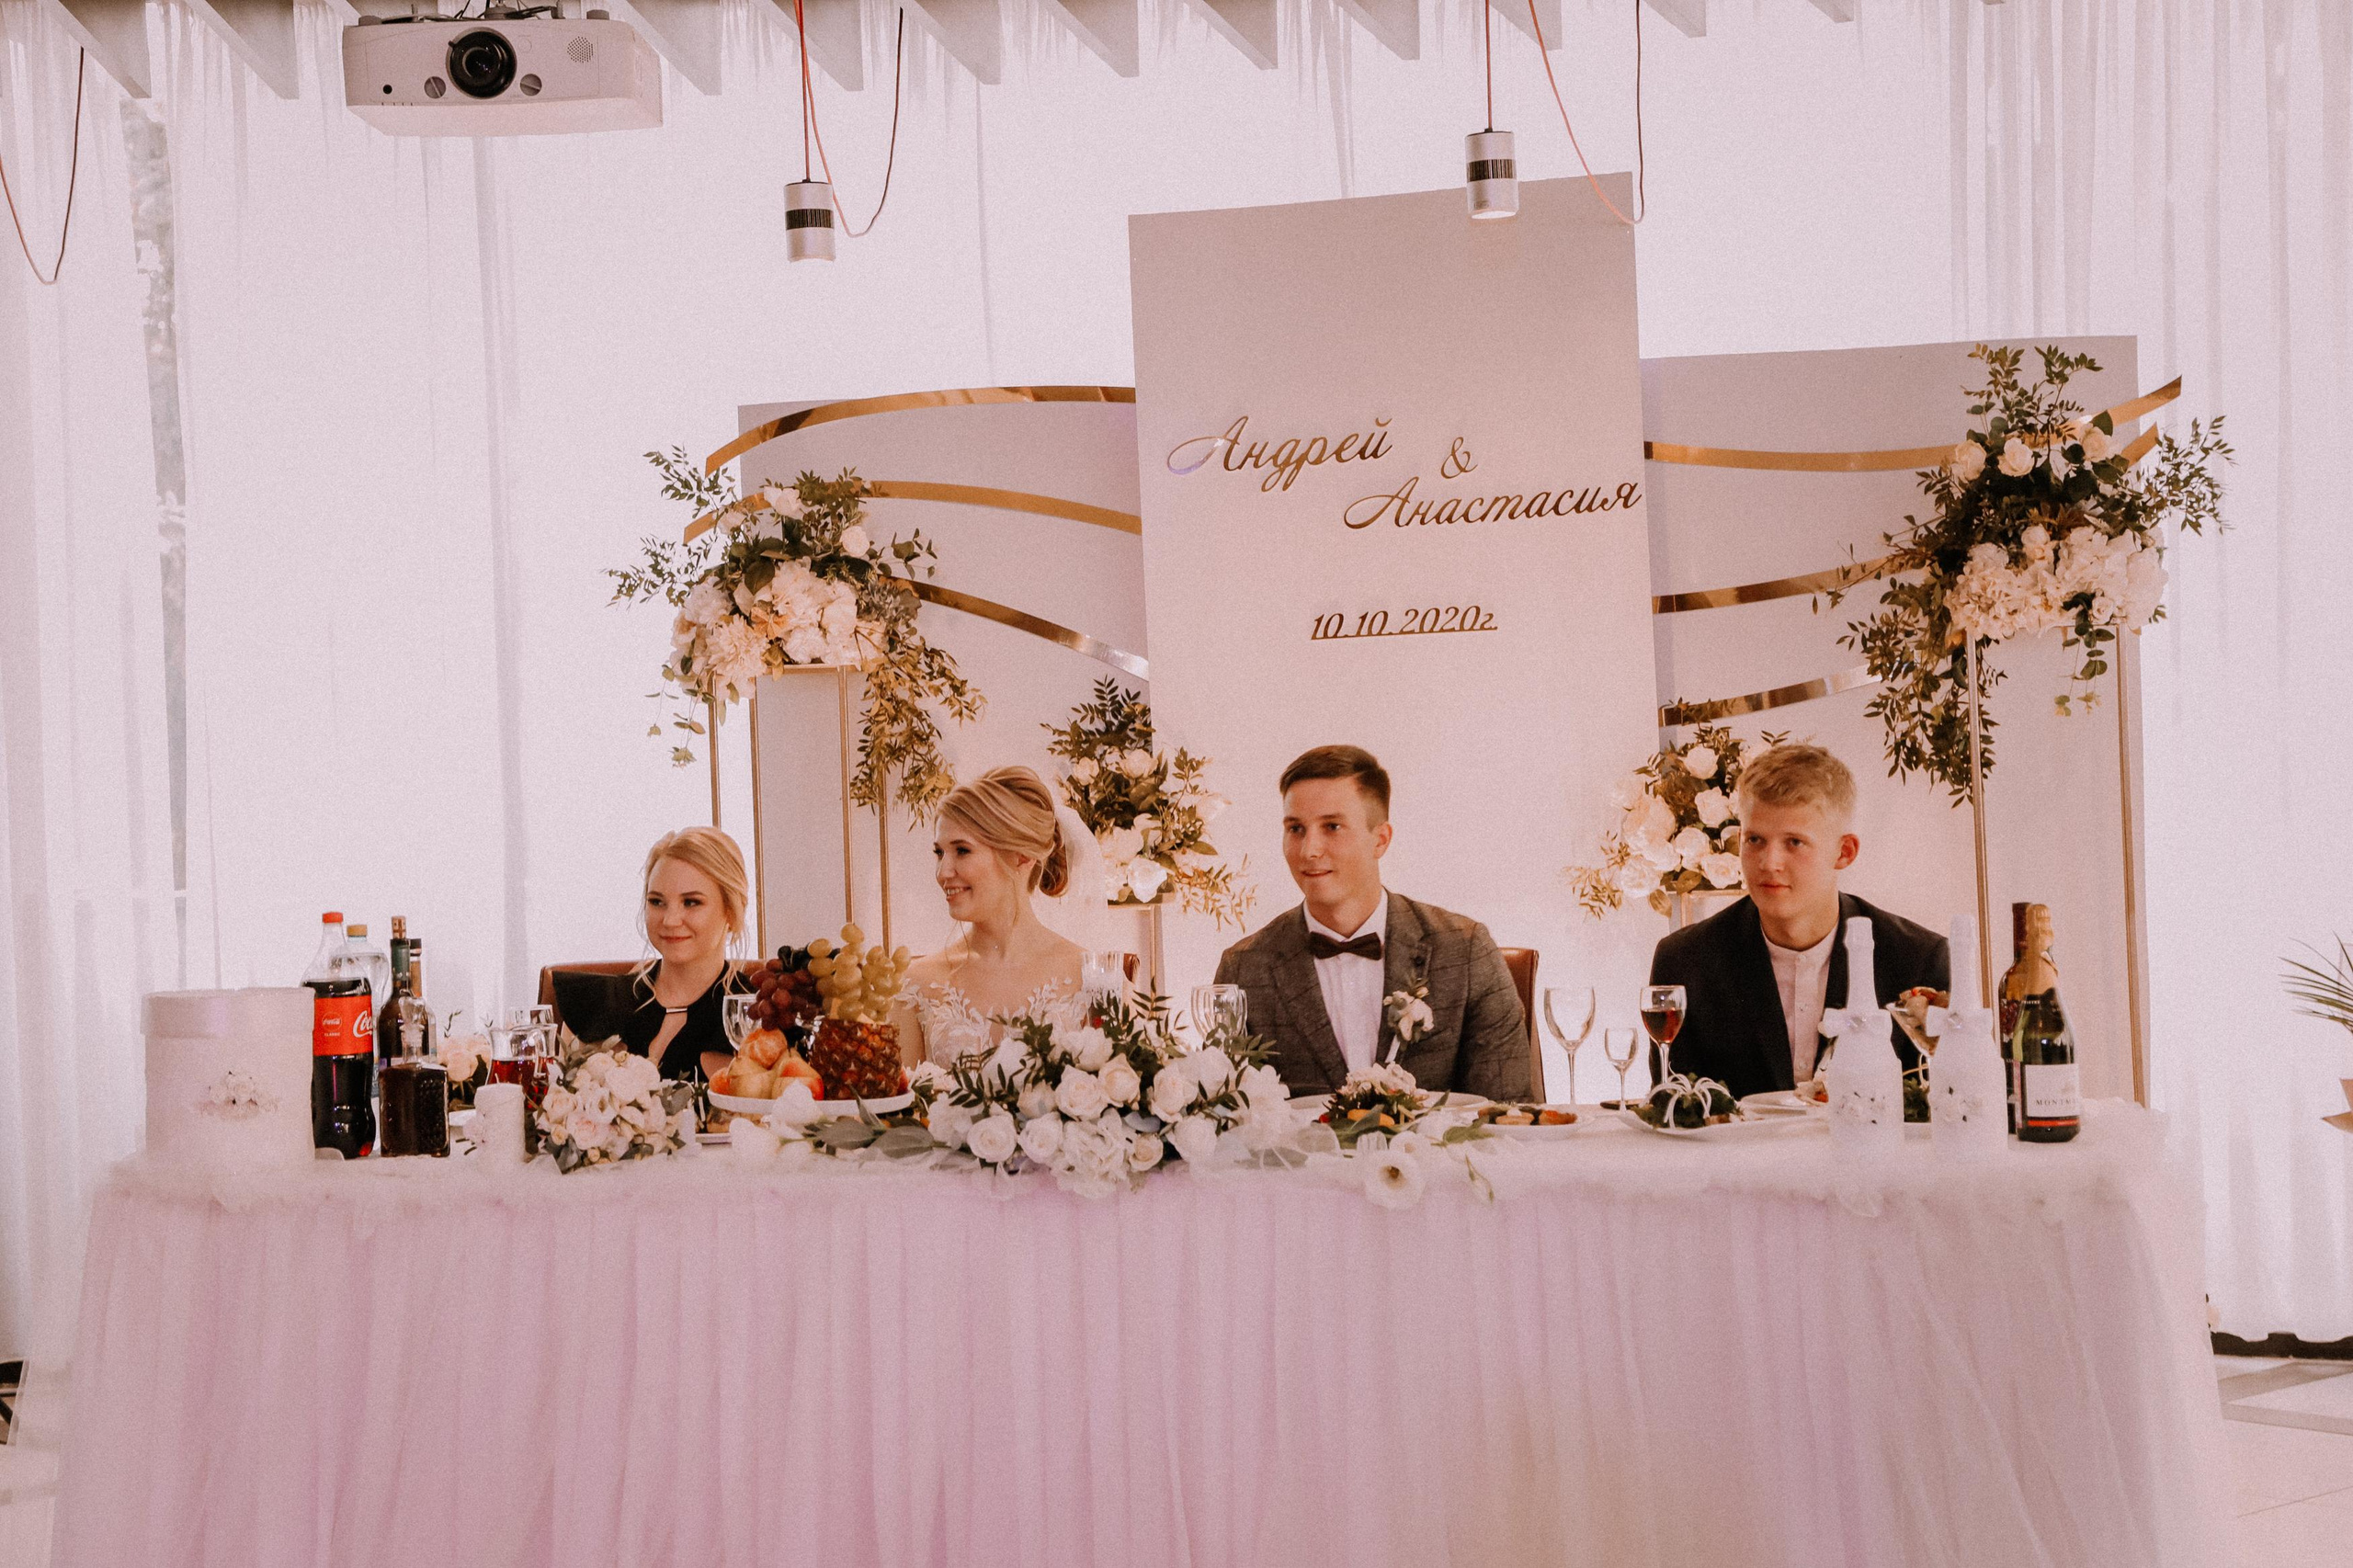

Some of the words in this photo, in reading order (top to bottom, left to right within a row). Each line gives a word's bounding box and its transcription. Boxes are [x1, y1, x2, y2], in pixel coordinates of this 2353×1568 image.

[1166, 415, 1392, 492] Андрей
[1440, 437, 1478, 479] &
[1344, 477, 1643, 529] Анастасия
